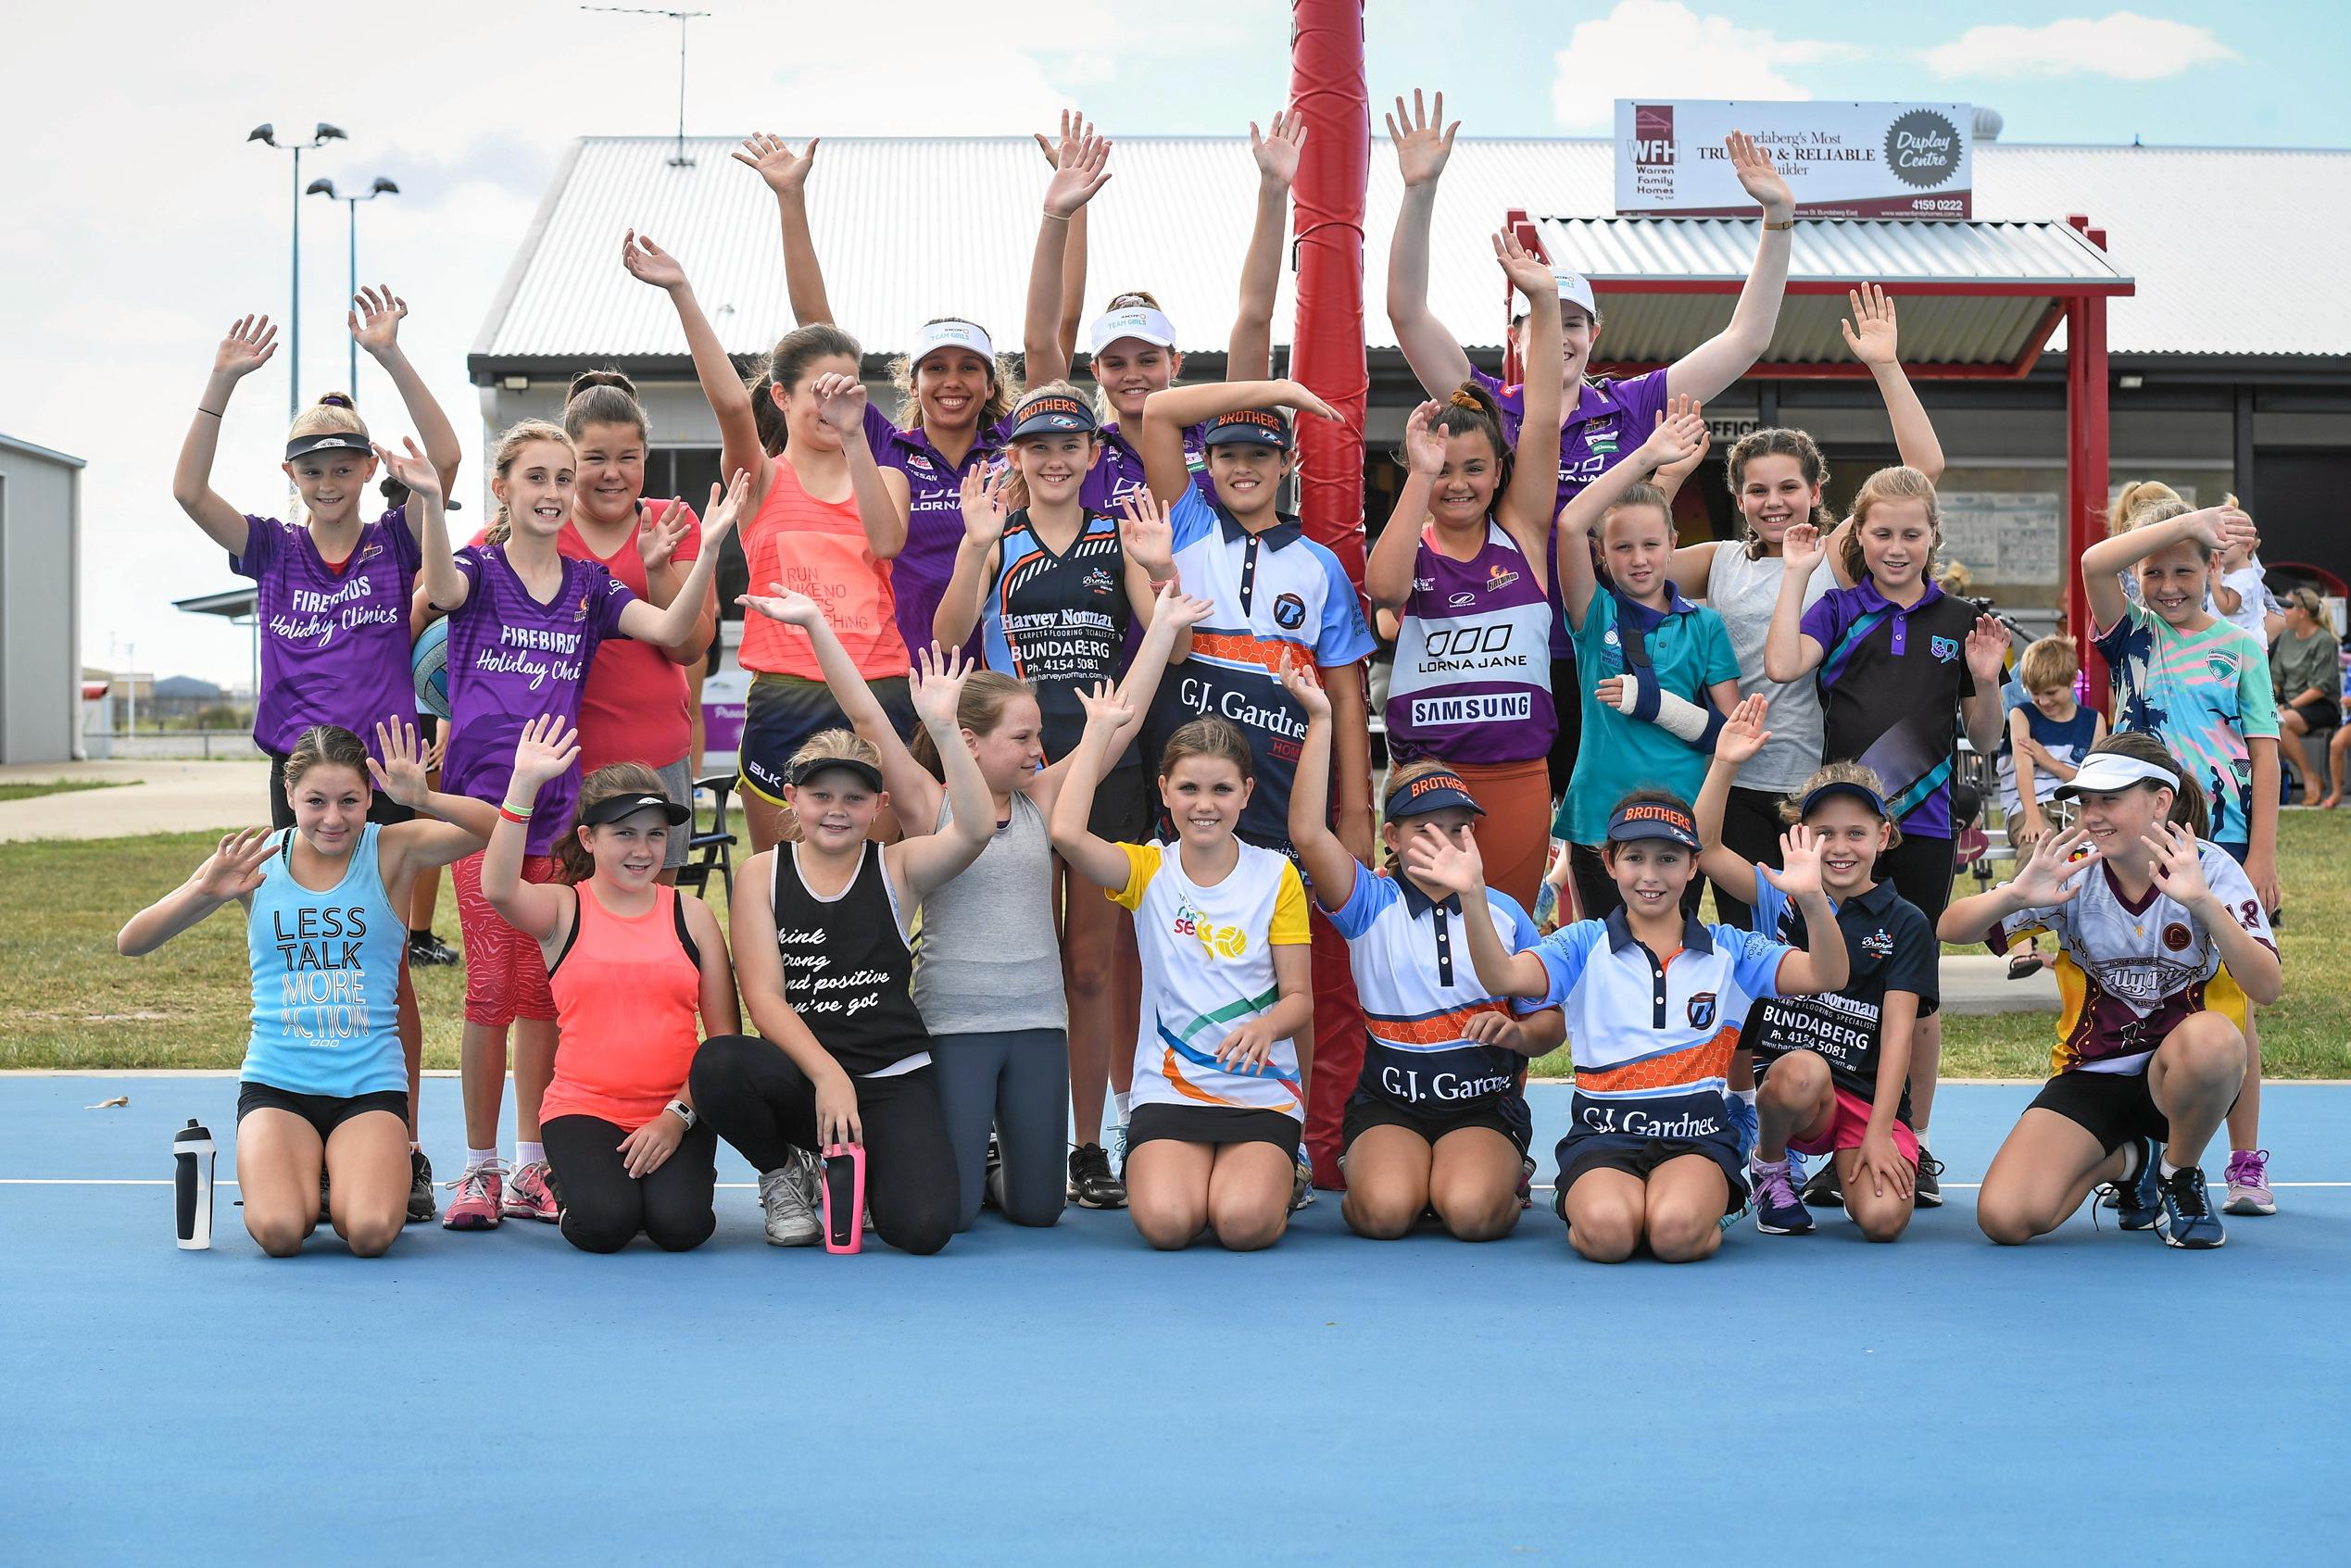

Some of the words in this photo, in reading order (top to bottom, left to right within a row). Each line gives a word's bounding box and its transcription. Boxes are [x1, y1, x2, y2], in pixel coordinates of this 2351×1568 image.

[1811, 132, 1842, 144] Most
[1896, 130, 1951, 155] Display
[1627, 139, 1681, 164] WFH
[1777, 148, 1791, 160] &
[1795, 148, 1876, 161] RELIABLE
[1899, 150, 1948, 168] Centre
[1636, 167, 1675, 175] Warren
[1638, 176, 1674, 186] Family
[1772, 163, 1809, 176] uilder
[1637, 185, 1675, 194] Homes
[1911, 199, 1936, 211] 4159
[1937, 199, 1964, 211] 0222
[930, 332, 949, 341] TEAM
[950, 332, 969, 341] GIRLS
[1107, 320, 1126, 330] TEAM
[1127, 318, 1147, 326] GIRLS
[1018, 398, 1078, 424] BROTHERS
[1218, 410, 1280, 432] BROTHERS
[786, 567, 819, 583] RUN
[823, 583, 847, 598] NO
[270, 614, 336, 648] Holiday
[341, 604, 398, 631] Clinics
[1000, 611, 1059, 629] Harvey
[1019, 631, 1044, 640] CARPET
[1050, 629, 1083, 637] FLOORING
[1012, 639, 1110, 662] BUNDABERG
[476, 648, 548, 691] Holiday
[1026, 662, 1042, 673] Ph.
[1044, 659, 1074, 671] 4154
[1077, 657, 1100, 671] 5081
[1418, 659, 1476, 673] LORNA
[1477, 655, 1528, 669] JANE
[1181, 678, 1213, 715] G.J.
[1415, 696, 1528, 723] SAMSUNG
[748, 760, 782, 788] BLK
[1625, 806, 1692, 833] BROTHERS
[273, 907, 367, 942] LESS
[777, 927, 827, 945] hink
[276, 941, 364, 972] TALK
[282, 971, 367, 1006] MORE
[785, 973, 811, 990] nd
[812, 969, 890, 996] positive
[846, 992, 879, 1017] got
[1817, 991, 1880, 1020] Norman
[281, 1005, 371, 1039] ACTION
[1801, 1003, 1834, 1018] FLOORING
[1836, 1013, 1877, 1032] SPECIALISTS
[1787, 1031, 1816, 1048] 4154
[1817, 1040, 1847, 1060] 5081
[1382, 1066, 1427, 1103] G.J.
[1623, 1110, 1720, 1137] Gardner.
